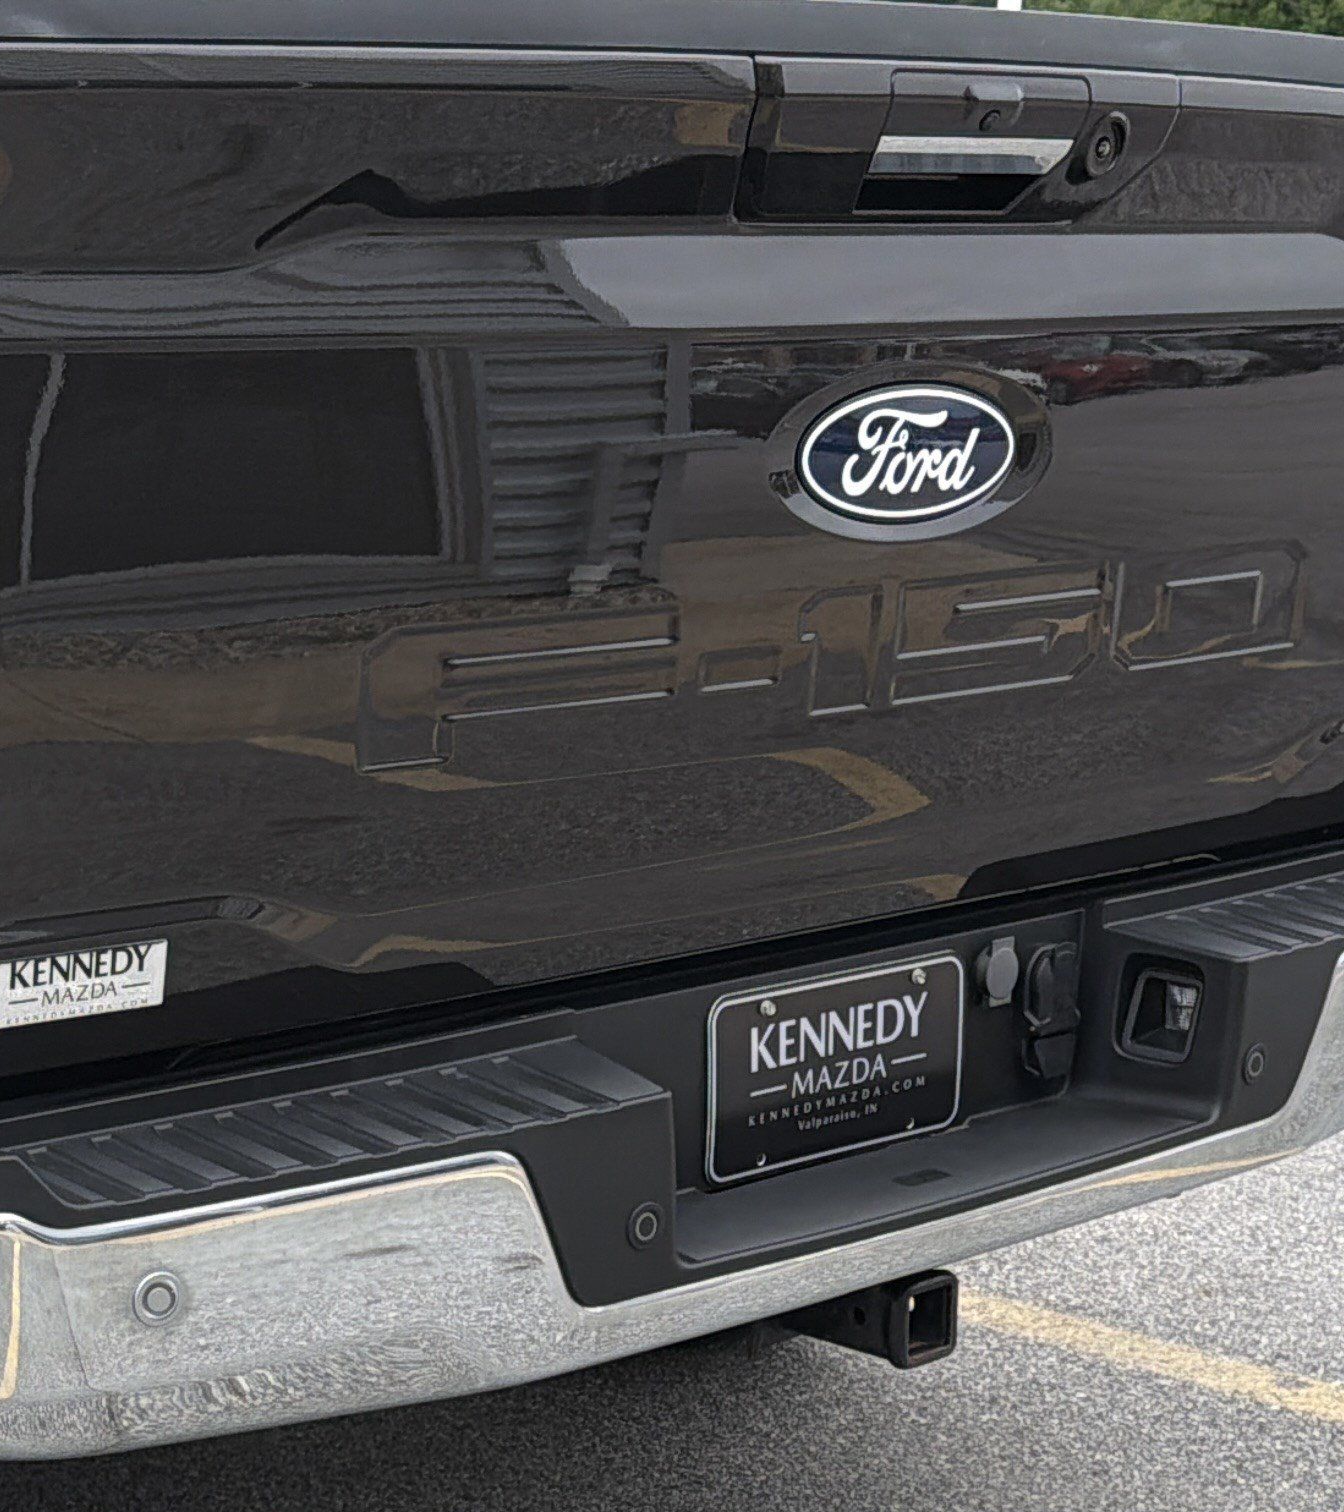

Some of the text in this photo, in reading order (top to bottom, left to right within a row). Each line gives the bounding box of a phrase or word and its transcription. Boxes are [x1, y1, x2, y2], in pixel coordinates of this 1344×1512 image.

[842, 408, 980, 496] Ford
[9, 945, 152, 990] KENNEDY
[41, 980, 118, 1007] MAZDA
[750, 991, 928, 1073] KENNEDY
[791, 1053, 887, 1099] MAZDA
[748, 1075, 926, 1127] KENNEDYMAZDA.COM
